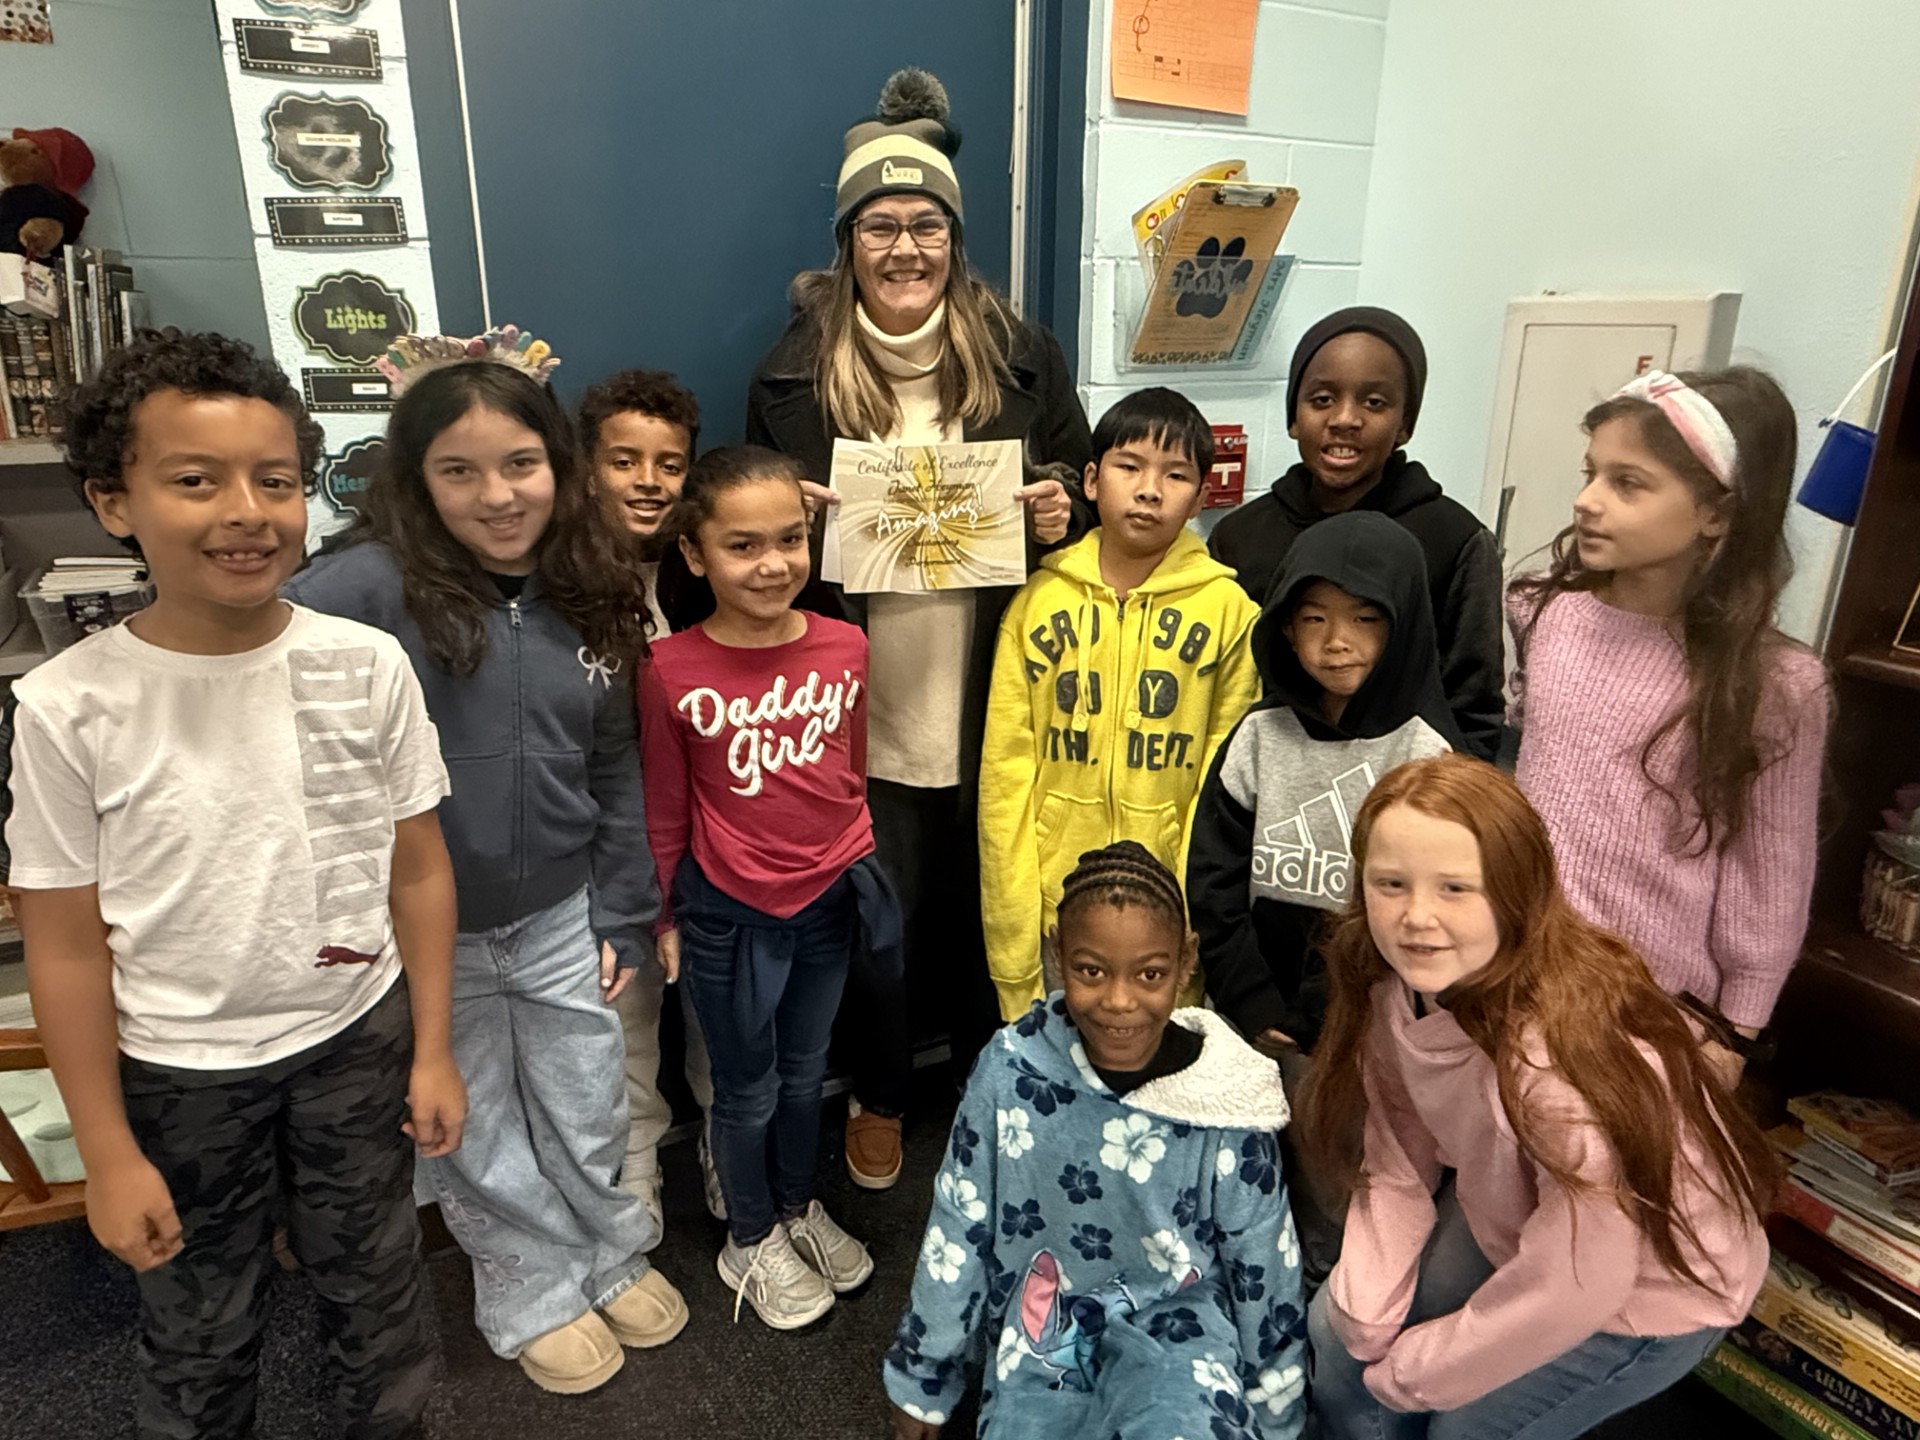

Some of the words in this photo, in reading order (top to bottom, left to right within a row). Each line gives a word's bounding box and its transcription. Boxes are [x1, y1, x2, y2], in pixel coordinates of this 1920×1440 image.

[324, 308, 387, 334] Lights
[1635, 355, 1653, 375] F
[857, 457, 919, 477] Certifiate
[939, 454, 999, 472] Excellence
[876, 482, 984, 541] Amazing!
[1043, 726, 1099, 766] TH.
[1250, 845, 1350, 904] adid
[1765, 1381, 1832, 1433] GEOGRAPHY
[1801, 1361, 1874, 1414] CARMEN
